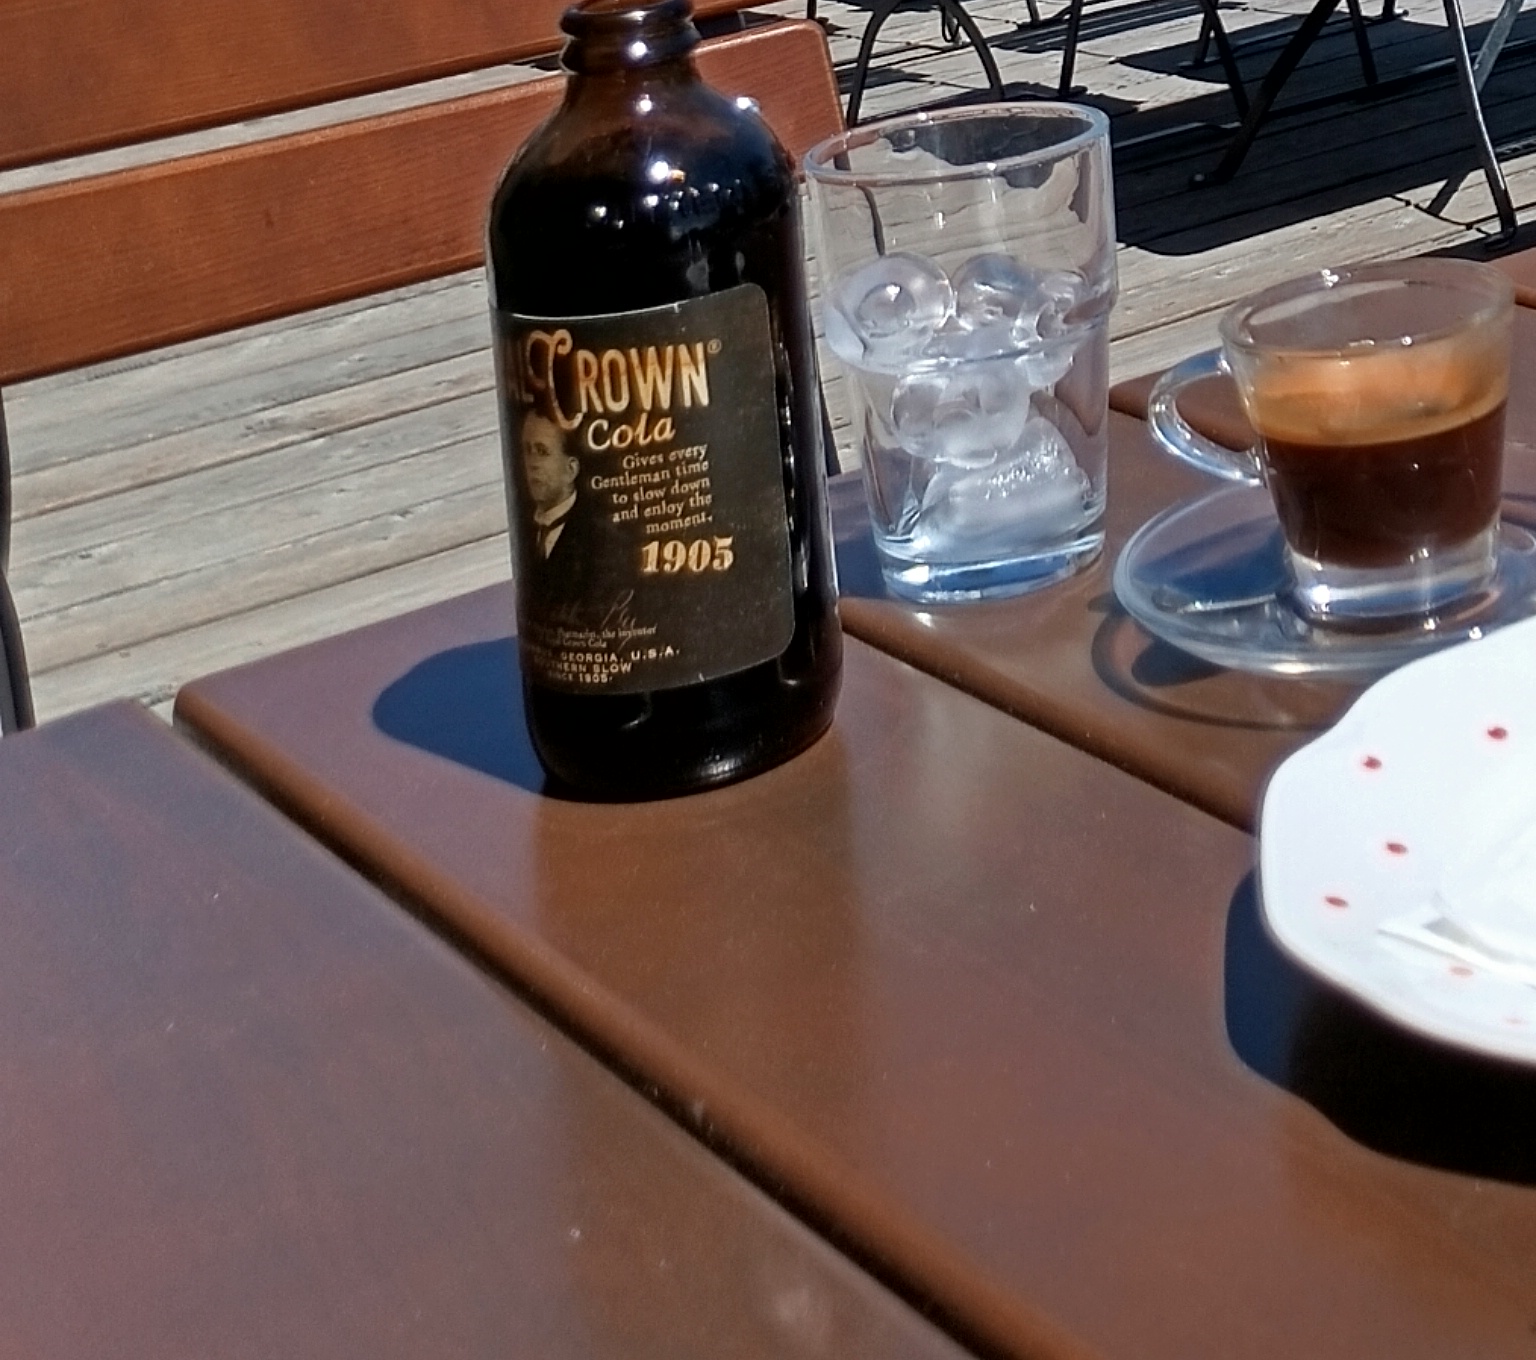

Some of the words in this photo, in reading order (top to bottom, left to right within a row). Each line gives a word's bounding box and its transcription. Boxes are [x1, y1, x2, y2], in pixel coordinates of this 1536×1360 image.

[587, 412, 676, 450] Cola
[622, 452, 664, 470] Gives
[668, 443, 708, 460] every
[591, 469, 671, 489] Gentleman
[675, 460, 710, 476] time
[612, 492, 628, 504] to
[632, 486, 667, 502] slow
[670, 477, 711, 495] down
[612, 504, 639, 523] and
[688, 491, 713, 508] the
[645, 511, 713, 534] moment.
[642, 535, 734, 573] 1905
